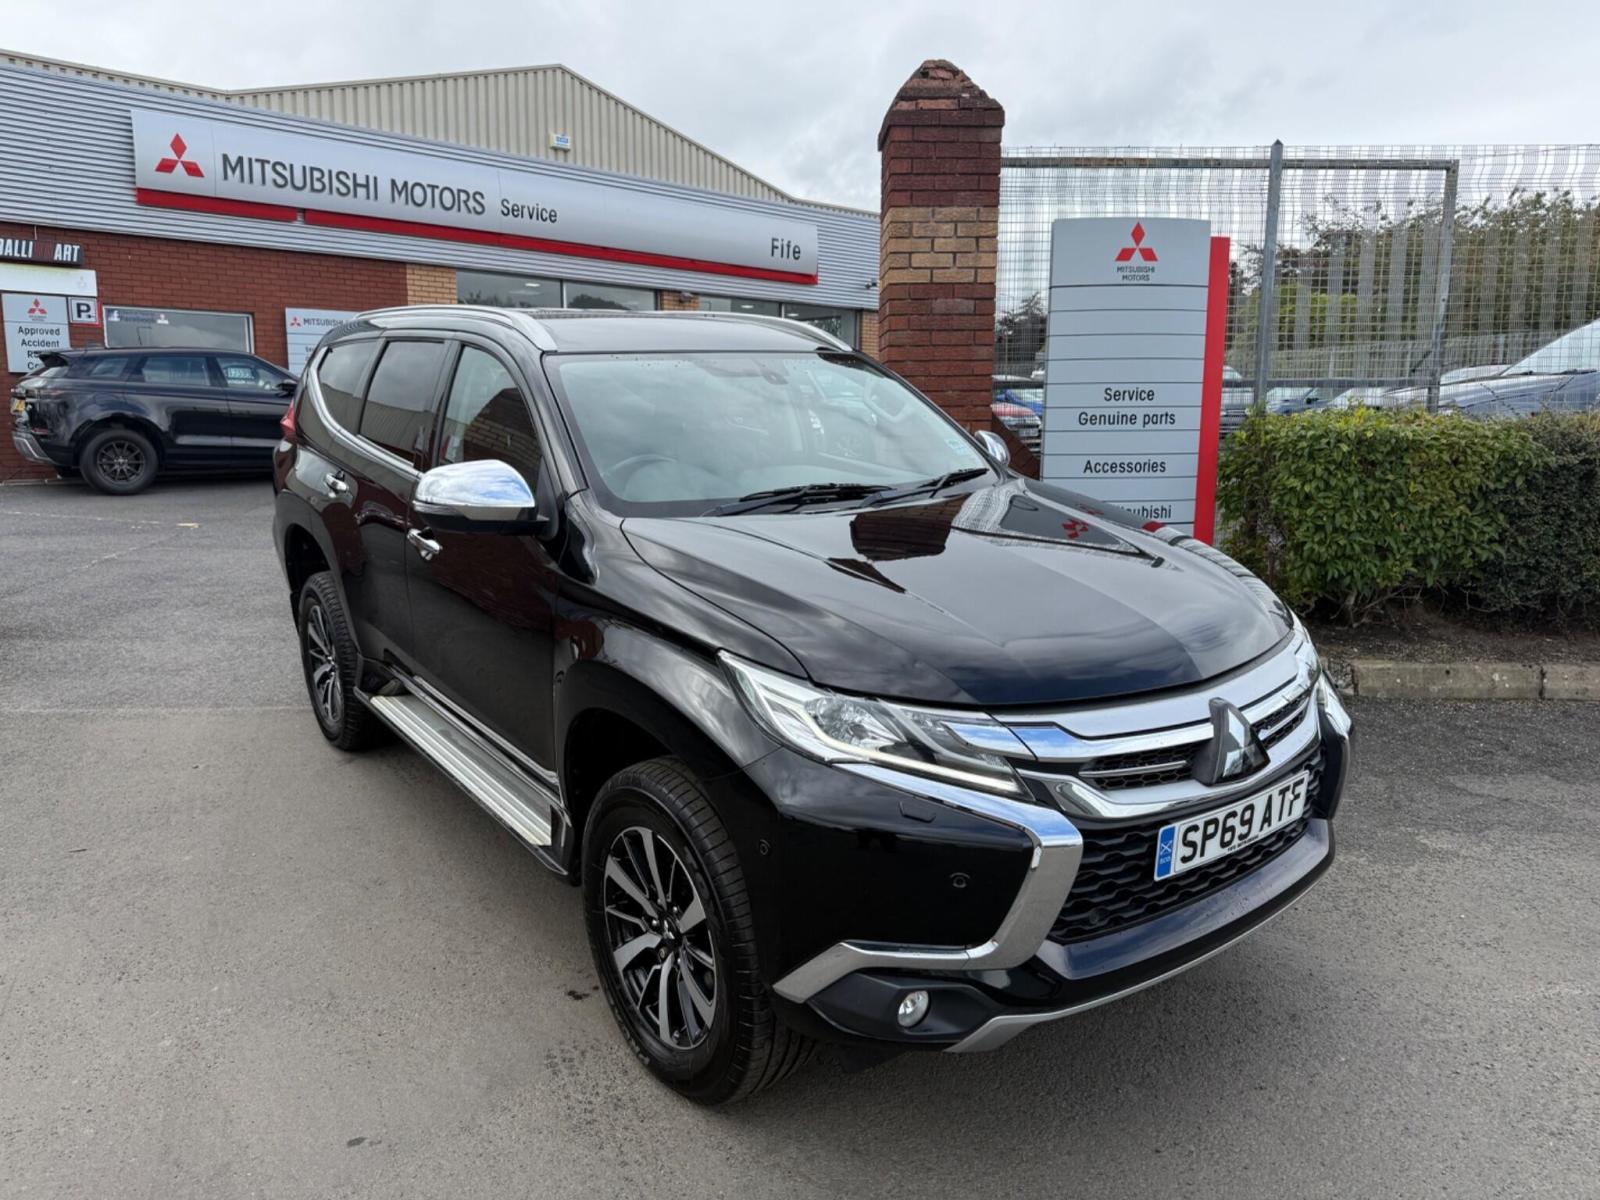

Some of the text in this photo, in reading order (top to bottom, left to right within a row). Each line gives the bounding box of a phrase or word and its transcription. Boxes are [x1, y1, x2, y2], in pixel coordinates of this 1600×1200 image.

[222, 153, 485, 216] MITSUBISHI MOTORS
[500, 198, 558, 224] Service
[54, 243, 80, 262] ART
[771, 237, 801, 261] Fife
[18, 326, 60, 337] Approved
[21, 338, 60, 348] Accident
[1103, 387, 1155, 401] Service
[1078, 411, 1176, 428] Genuine parts
[1083, 459, 1167, 473] Accessories
[1180, 777, 1305, 864] SP69 ATF
